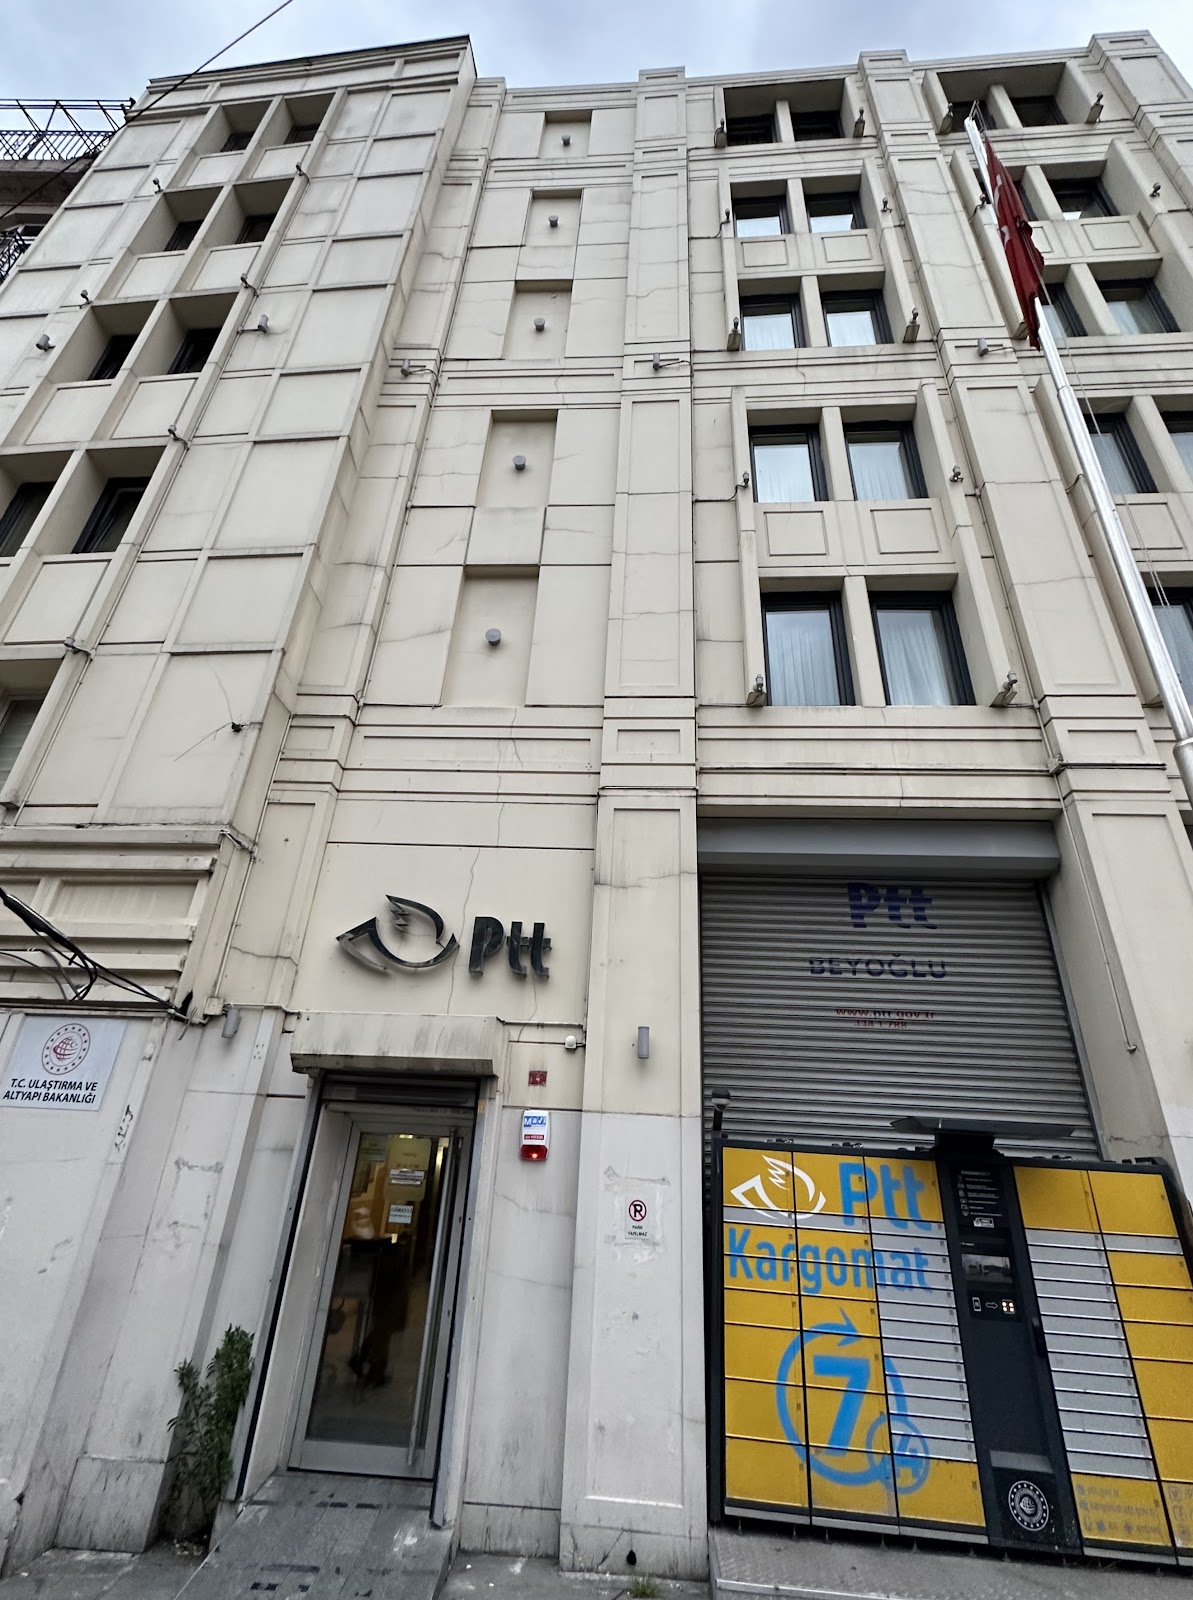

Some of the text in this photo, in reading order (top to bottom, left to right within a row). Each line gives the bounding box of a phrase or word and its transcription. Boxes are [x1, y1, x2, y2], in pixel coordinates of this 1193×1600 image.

[809, 952, 947, 978] BEYOĞLU
[3, 1090, 96, 1104] ALTYAPI BAKANLIĞI
[11, 1078, 98, 1091] T.C. ULAŞTIRMA VE
[838, 1161, 933, 1231] Ptt
[728, 1227, 933, 1295] Kargomat
